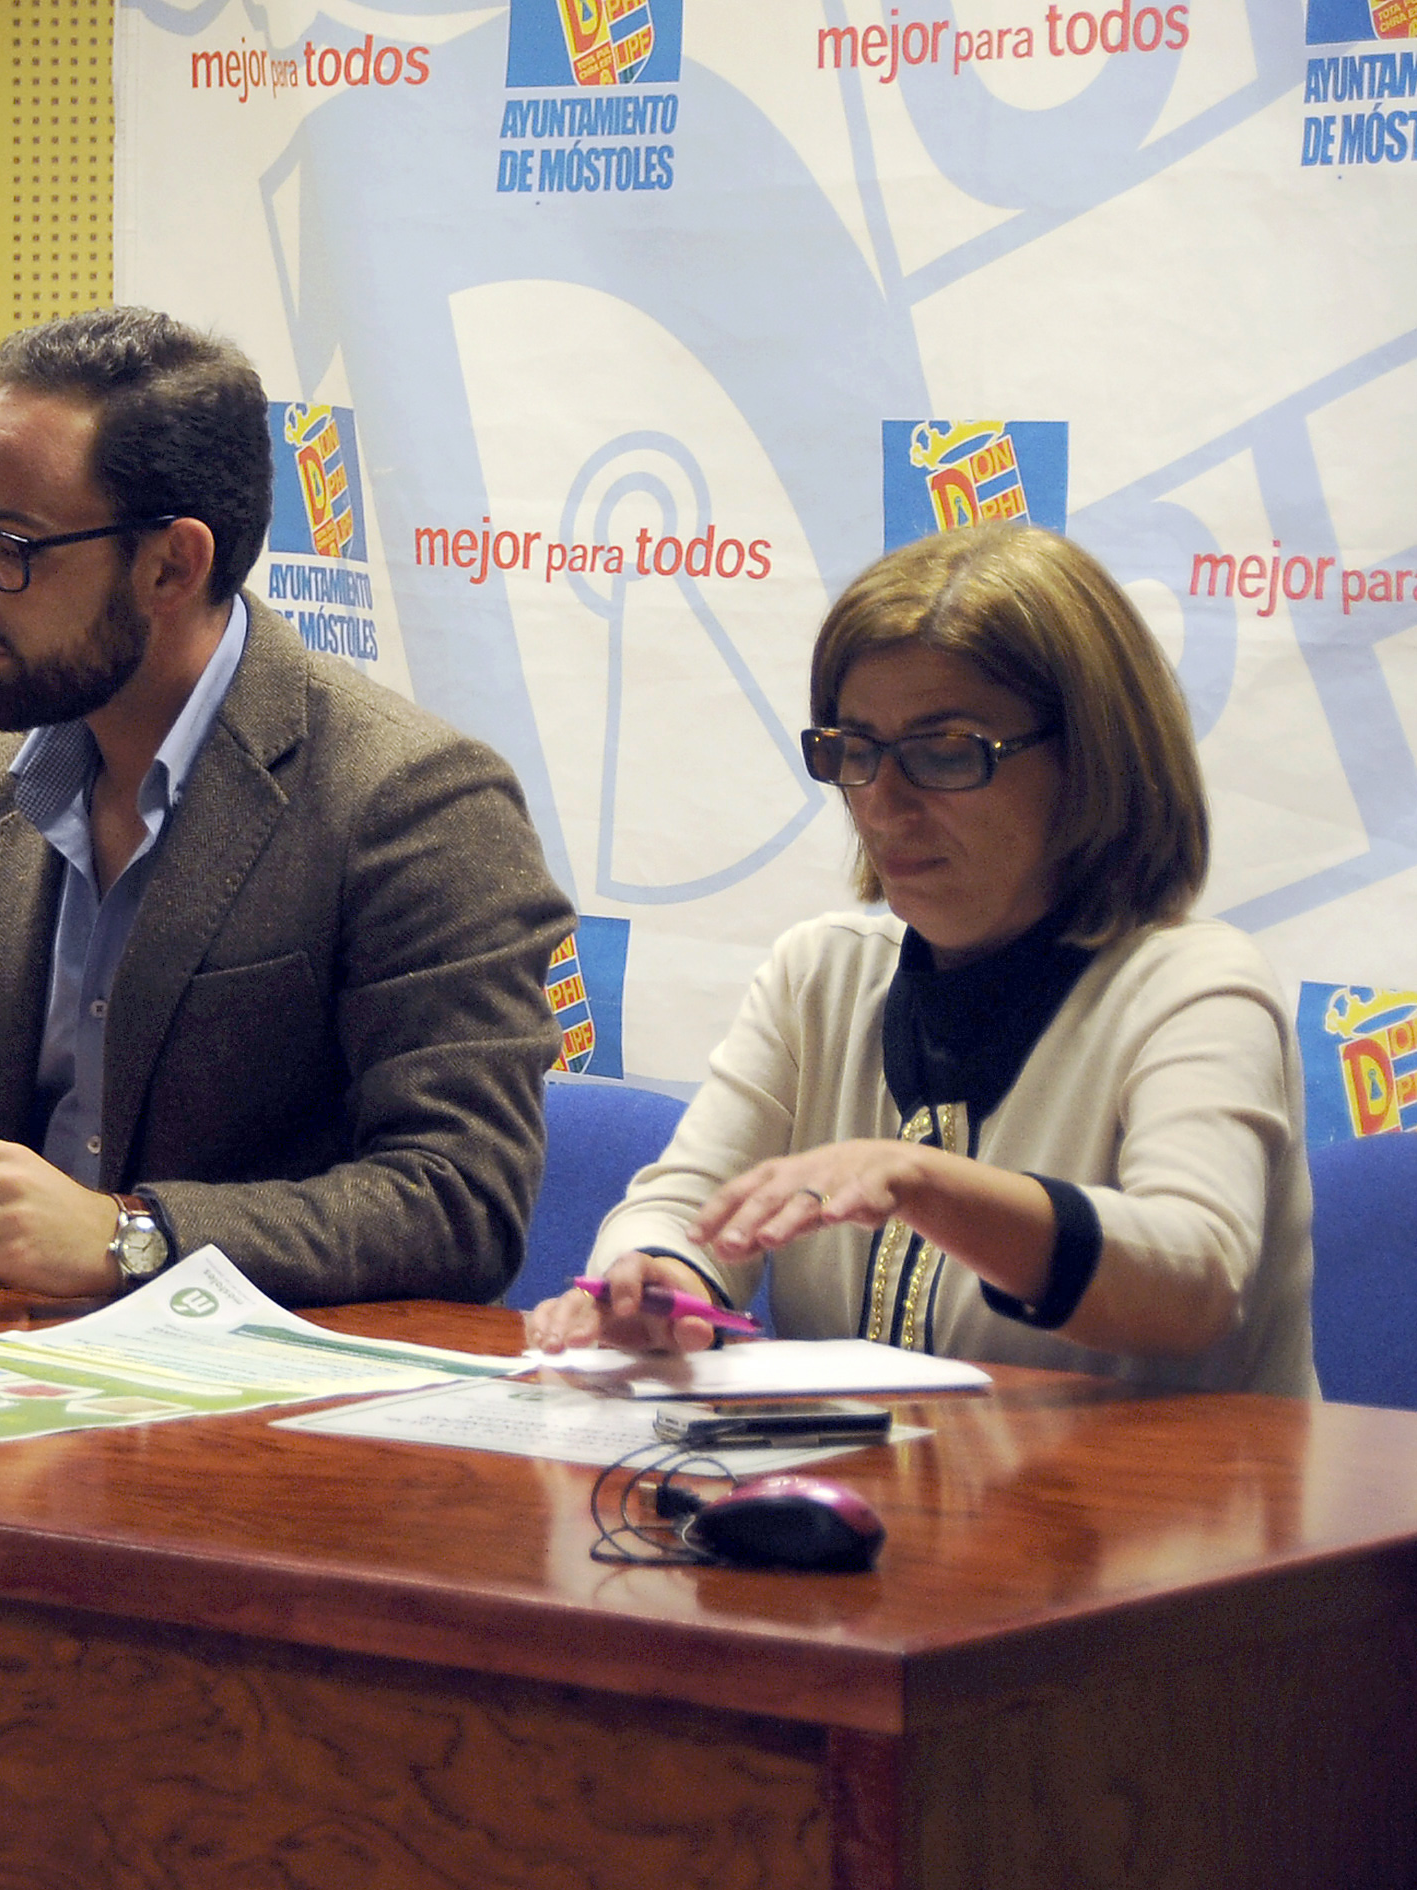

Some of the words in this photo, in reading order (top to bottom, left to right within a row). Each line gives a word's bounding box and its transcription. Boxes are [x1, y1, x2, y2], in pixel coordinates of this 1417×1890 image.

[191, 36, 267, 103] mejor
[270, 56, 298, 98] para
[303, 34, 430, 87] todos
[817, 8, 948, 84] mejor
[953, 27, 1033, 75] para
[1045, 0, 1190, 58] todos
[1304, 52, 1417, 104] AYUNTAM
[499, 94, 679, 138] AYUNTAMIENTO
[1301, 115, 1336, 167] DE
[1338, 102, 1417, 165] MÓST
[496, 149, 534, 192] DE
[538, 140, 674, 192] MÓSTOLES
[415, 516, 542, 585] mejor
[546, 541, 624, 583] para
[635, 524, 772, 580] todos
[1190, 539, 1335, 617] mejor
[1342, 569, 1417, 615] par
[268, 564, 373, 610] AYUNTAMIENTO
[298, 605, 378, 662] MÓSTOLES
